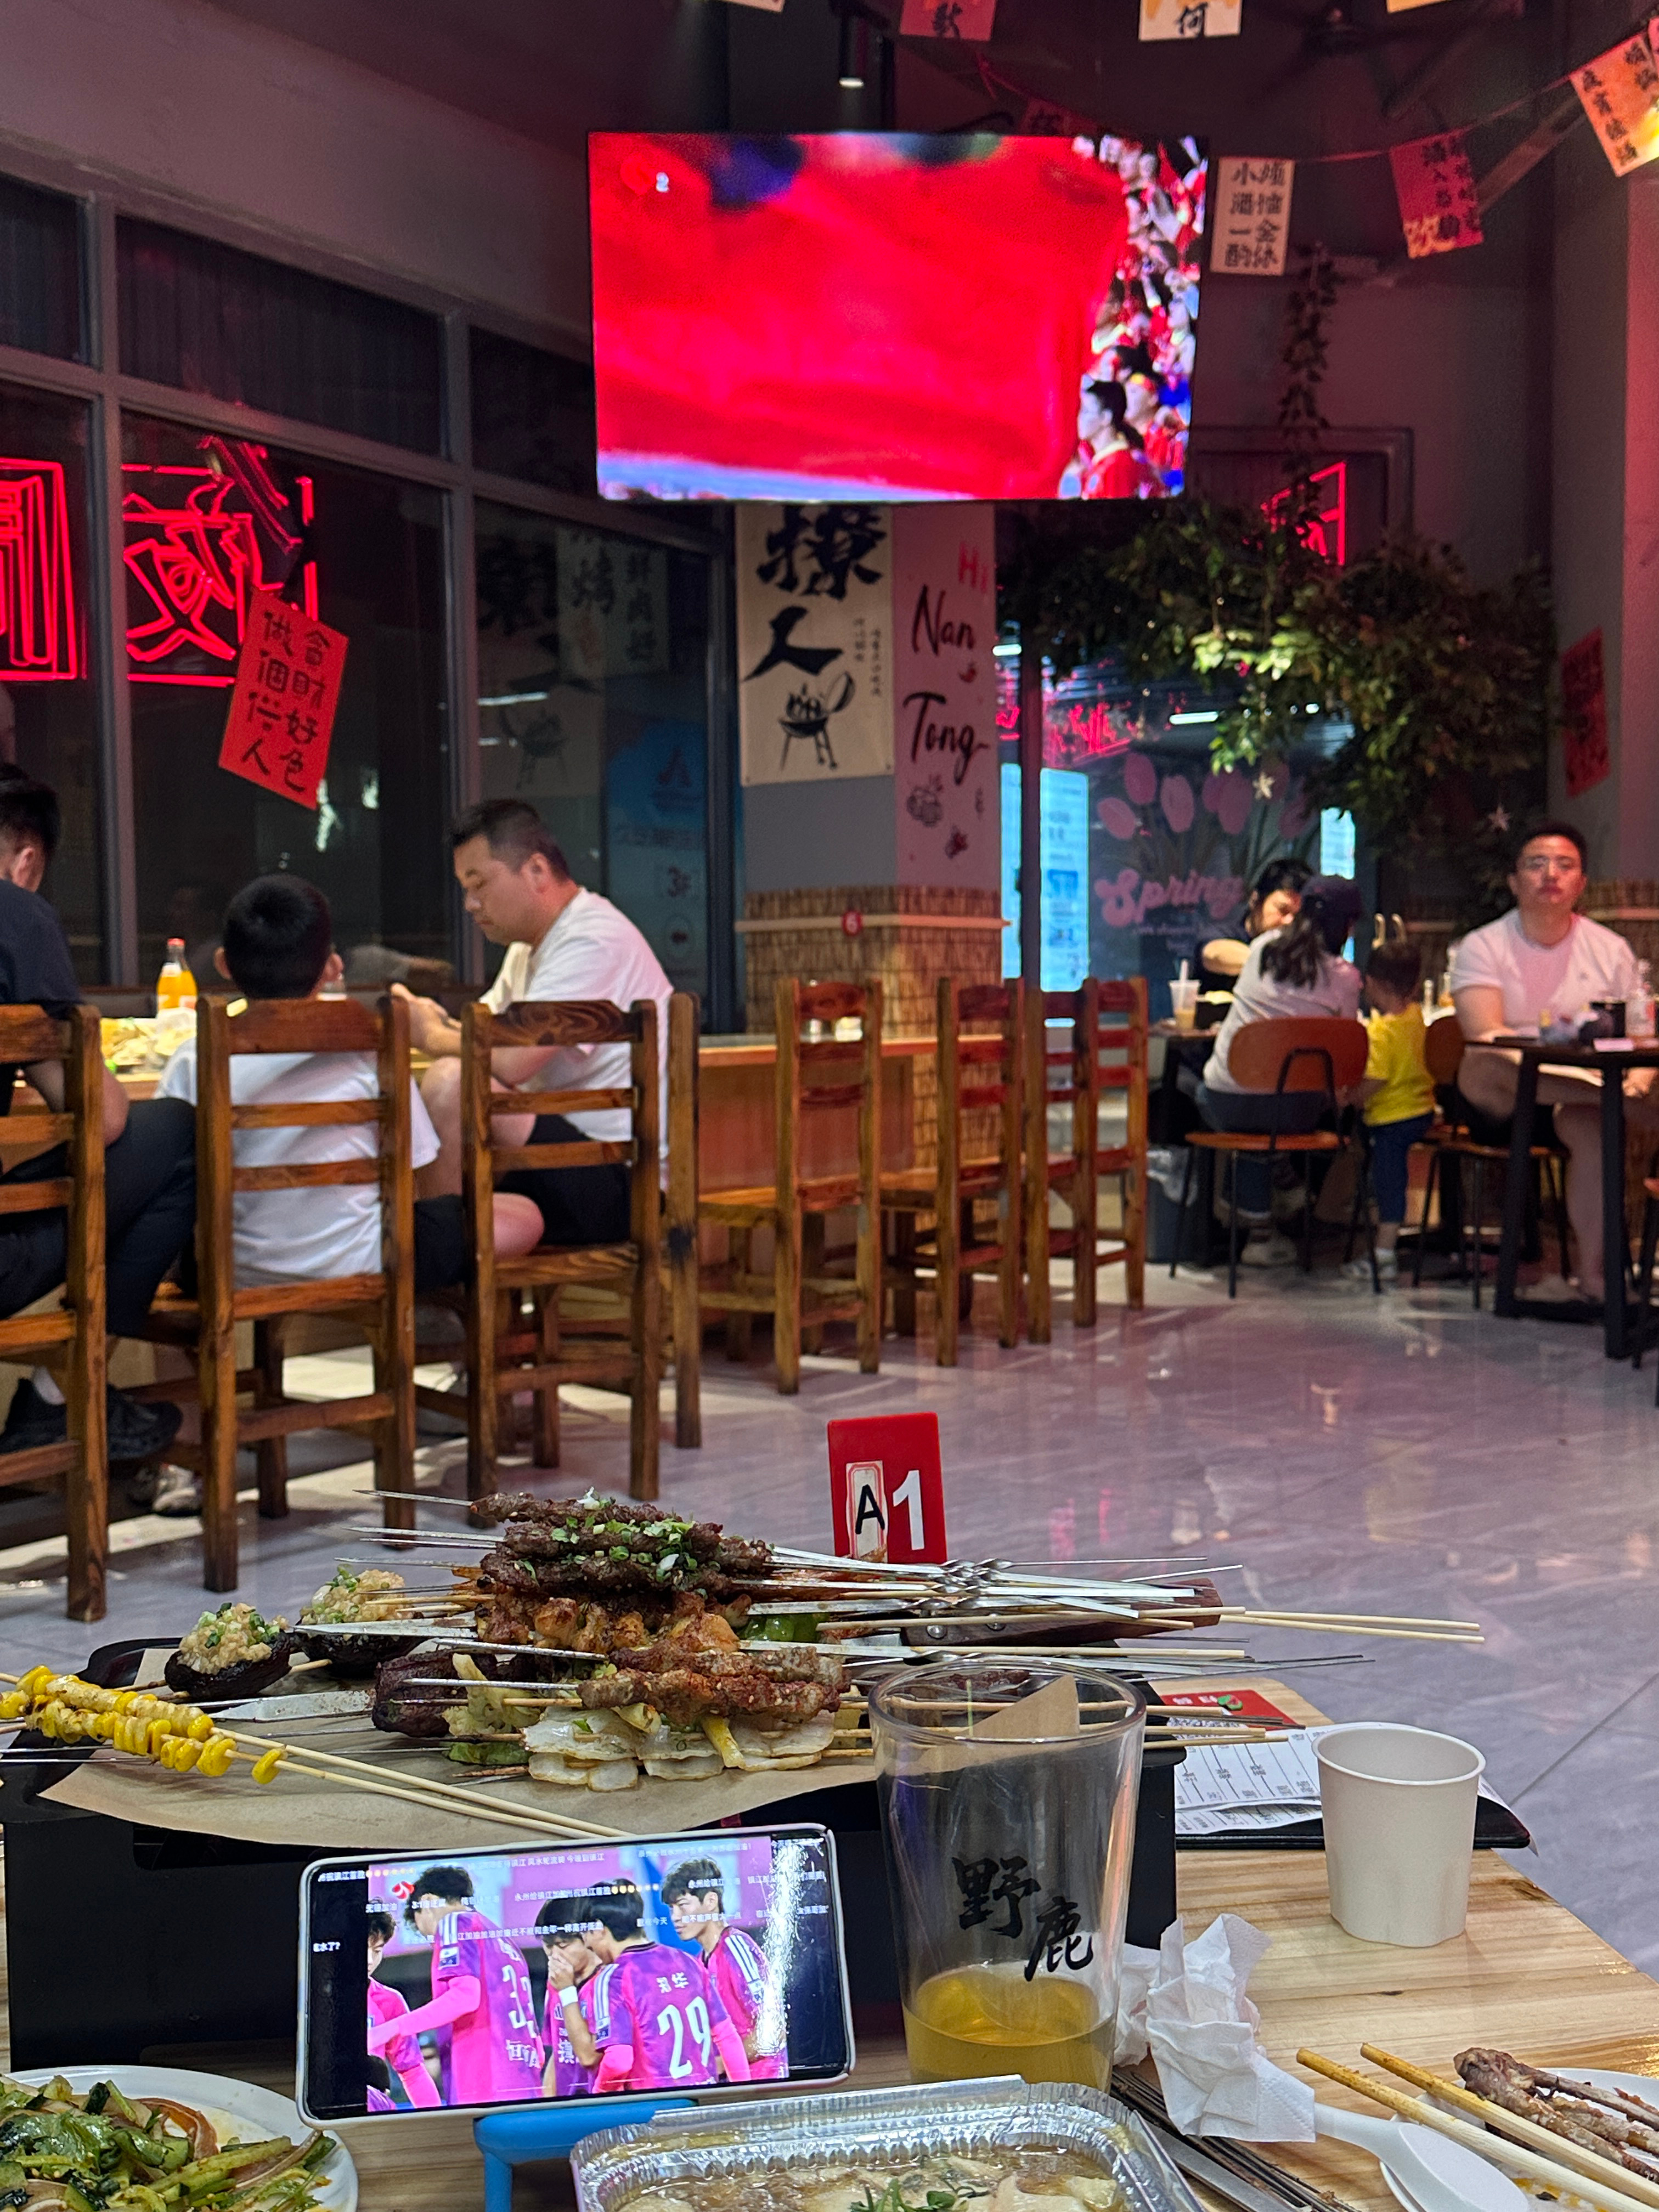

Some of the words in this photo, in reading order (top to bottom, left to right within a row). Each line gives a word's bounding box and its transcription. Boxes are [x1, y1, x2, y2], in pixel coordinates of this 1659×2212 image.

[1175, 3, 1210, 38] 何
[911, 583, 975, 656] Nan
[902, 691, 988, 786] Tong
[1094, 868, 1244, 928] Spring
[952, 1856, 1093, 1982] 野鹿
[657, 1996, 712, 2079] 29
